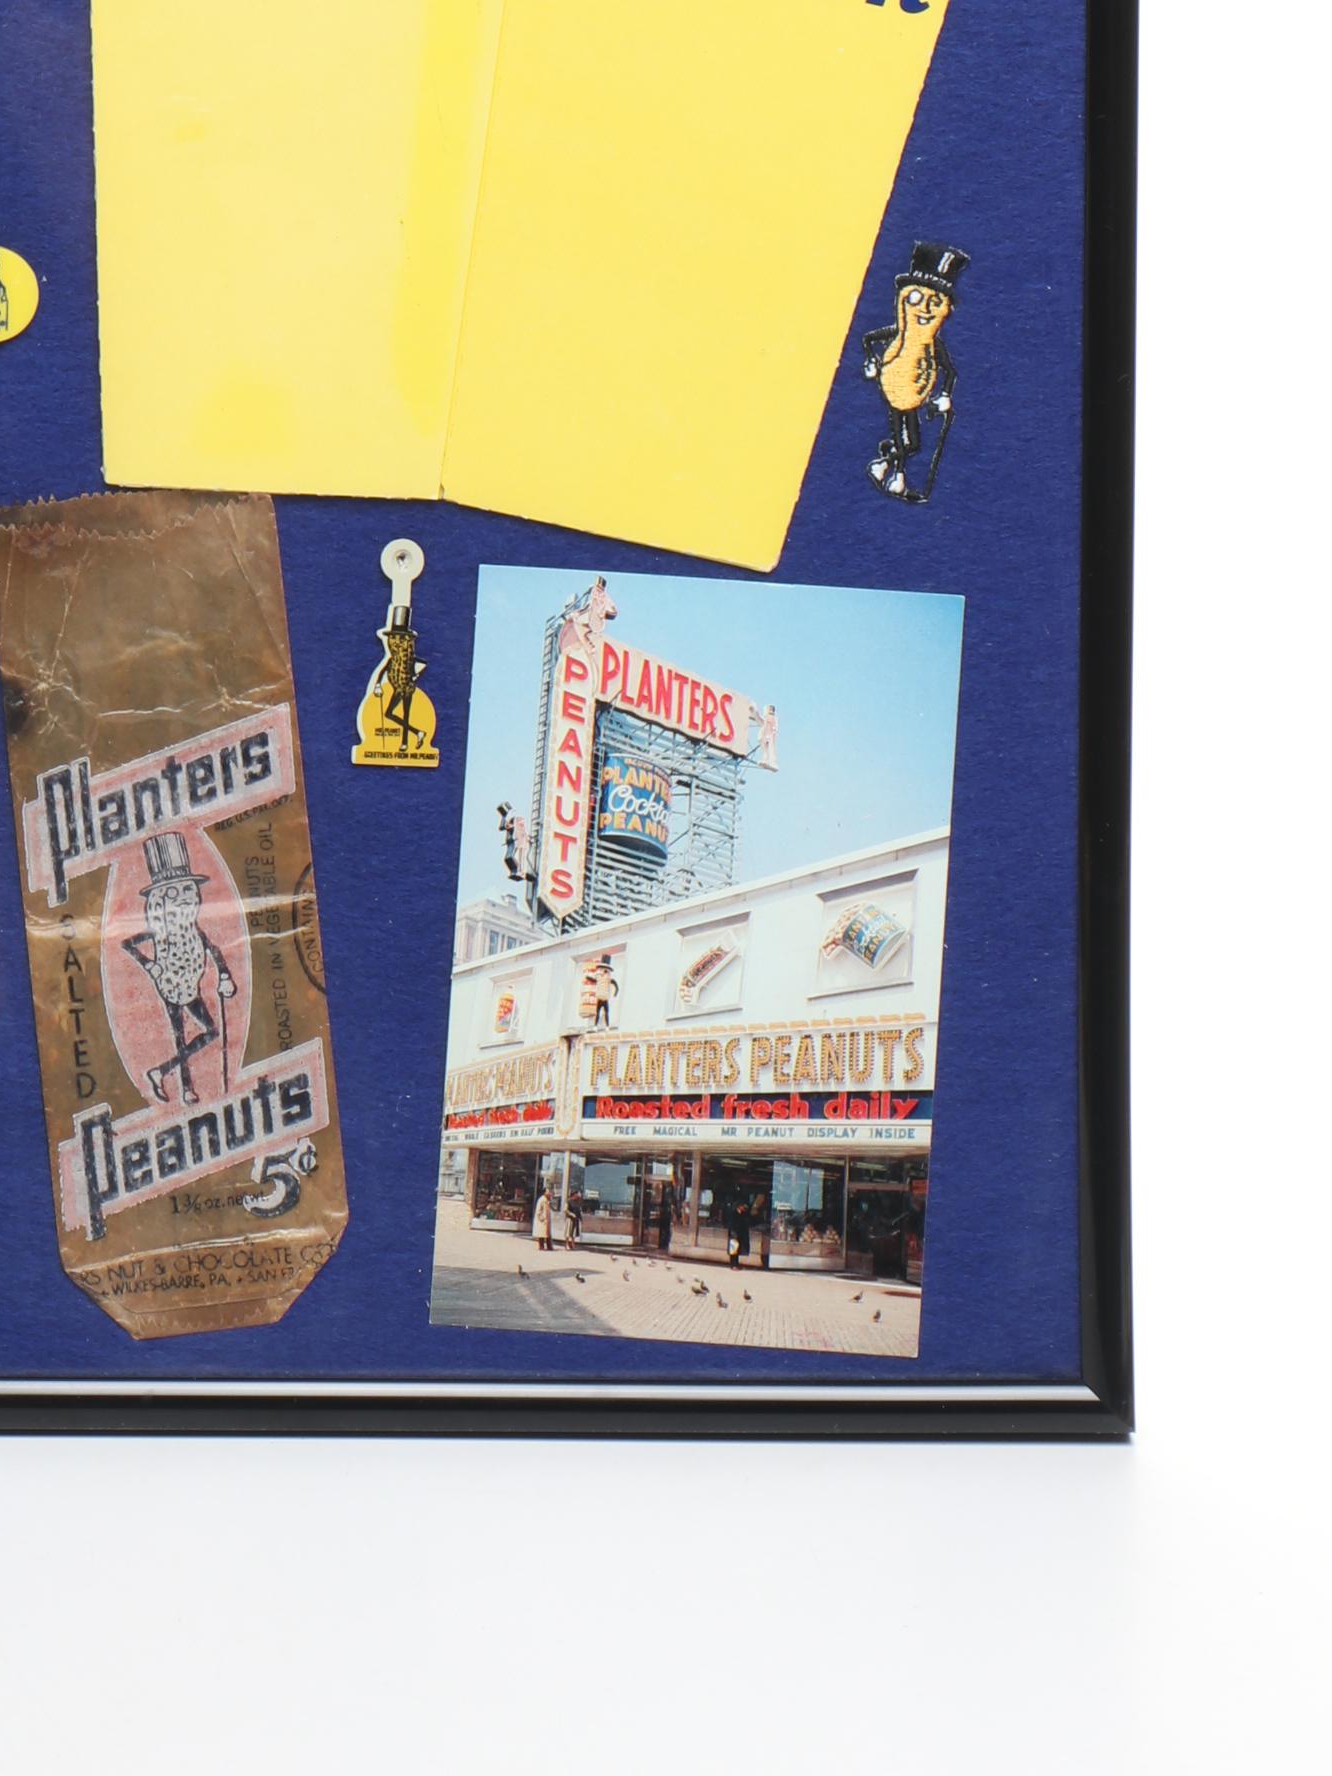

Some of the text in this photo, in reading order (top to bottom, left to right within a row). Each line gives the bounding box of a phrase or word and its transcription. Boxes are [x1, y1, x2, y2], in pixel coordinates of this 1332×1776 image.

[598, 642, 734, 742] PLANTERS
[44, 730, 273, 906] Planters
[550, 655, 588, 900] PEANUTS
[59, 913, 98, 1100] SALTED
[590, 1025, 926, 1089] PLANTERS PEANUTS
[595, 1090, 919, 1121] Roasted fresh daily
[81, 1070, 312, 1240] Peanuts
[250, 1142, 318, 1219] 5¢
[613, 1125, 916, 1140] FREE MAGICAL MR PEANUT DISPLAY INSIDE
